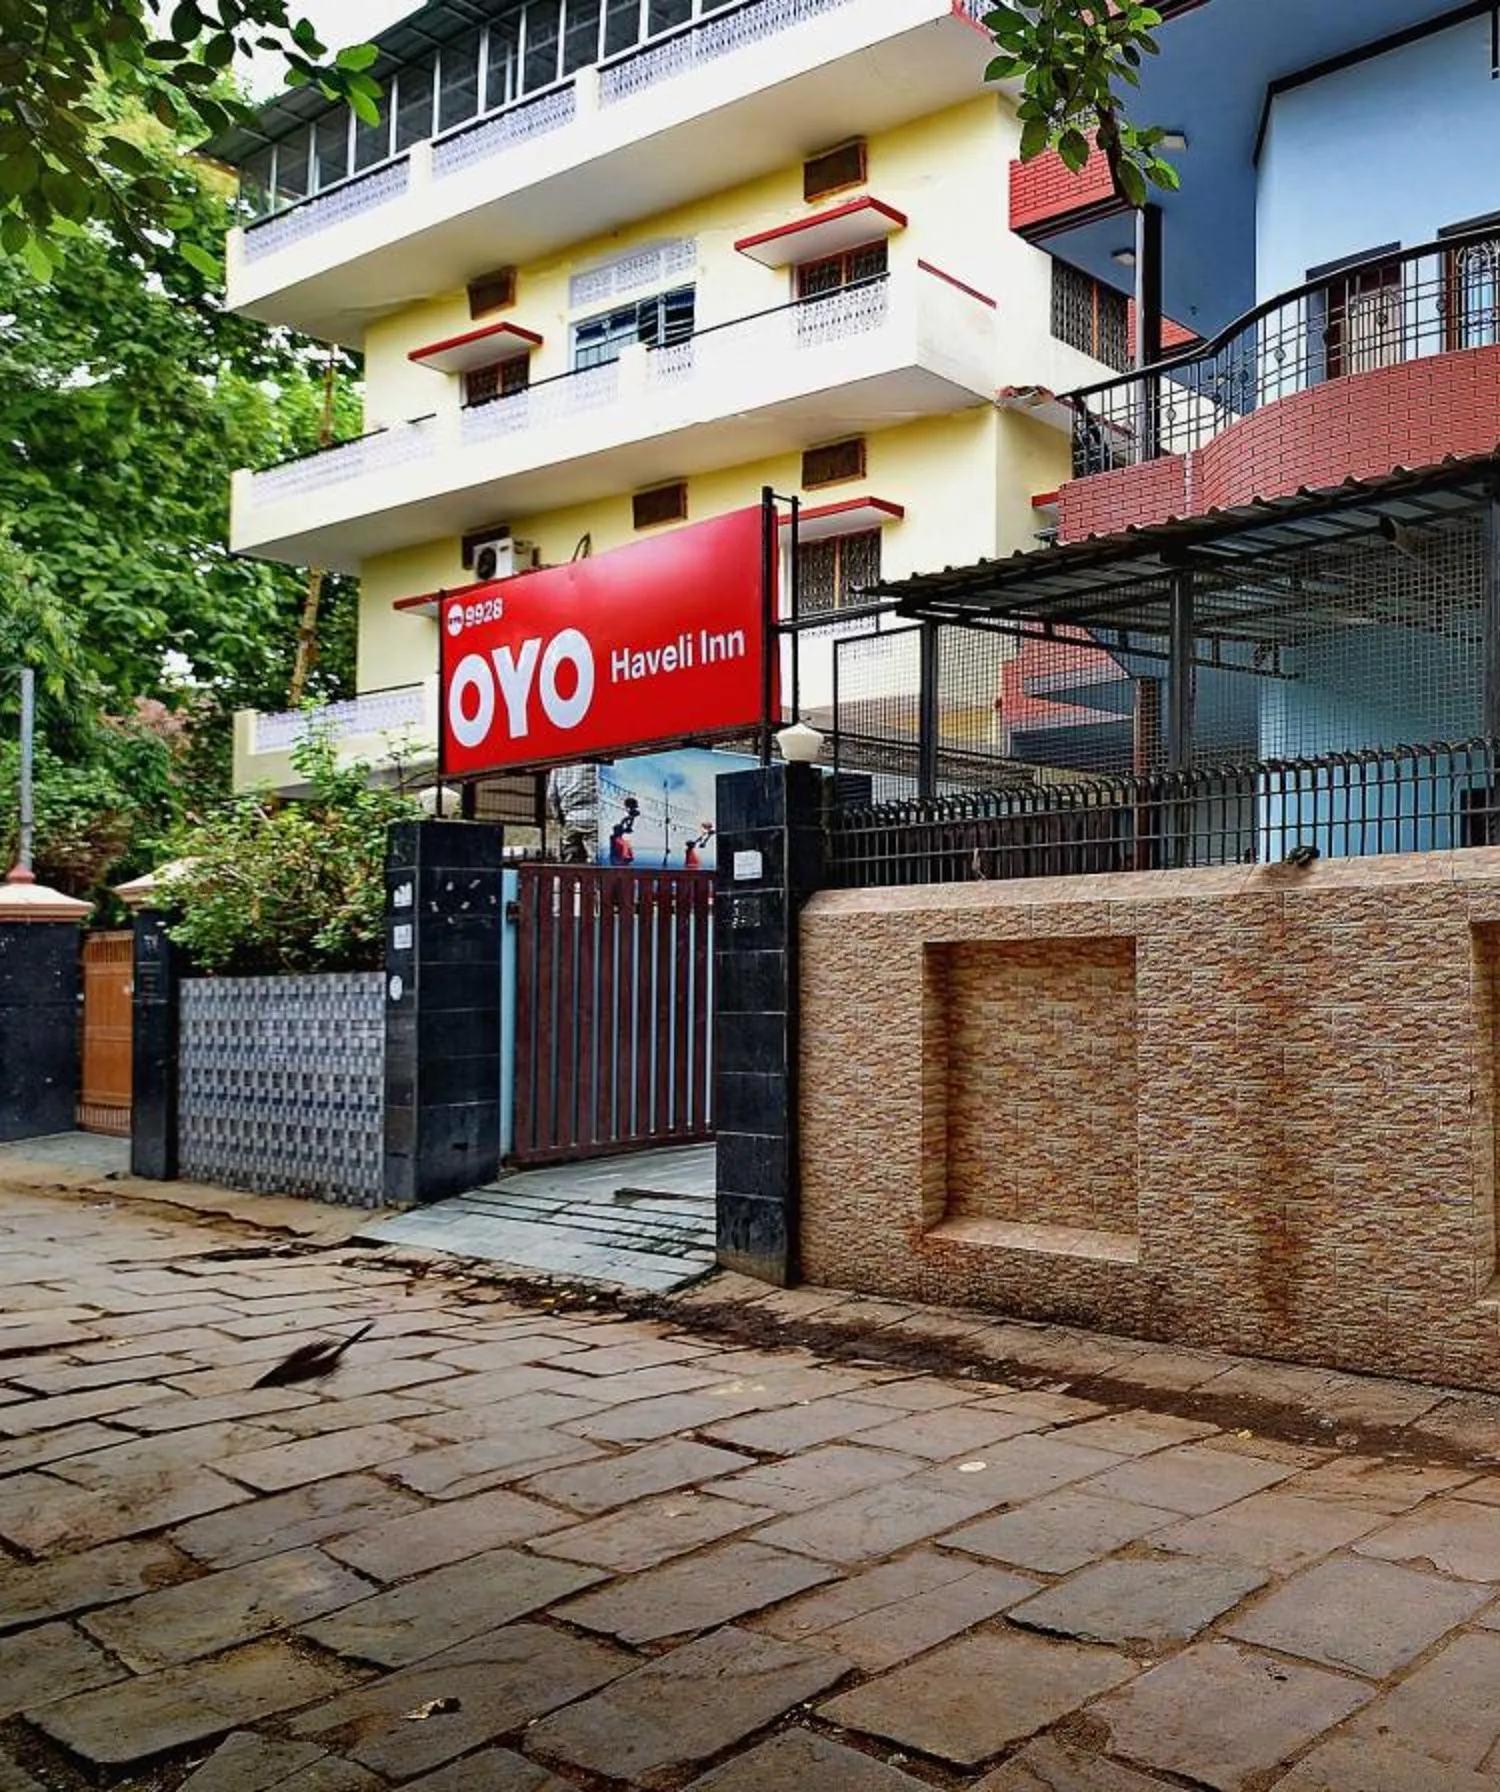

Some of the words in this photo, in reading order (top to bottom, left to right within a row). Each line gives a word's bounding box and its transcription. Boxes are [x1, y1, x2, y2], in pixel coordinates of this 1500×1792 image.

[465, 597, 503, 628] 9928
[611, 632, 693, 683] Haveli
[700, 628, 745, 665] Inn
[448, 627, 595, 748] OYO
